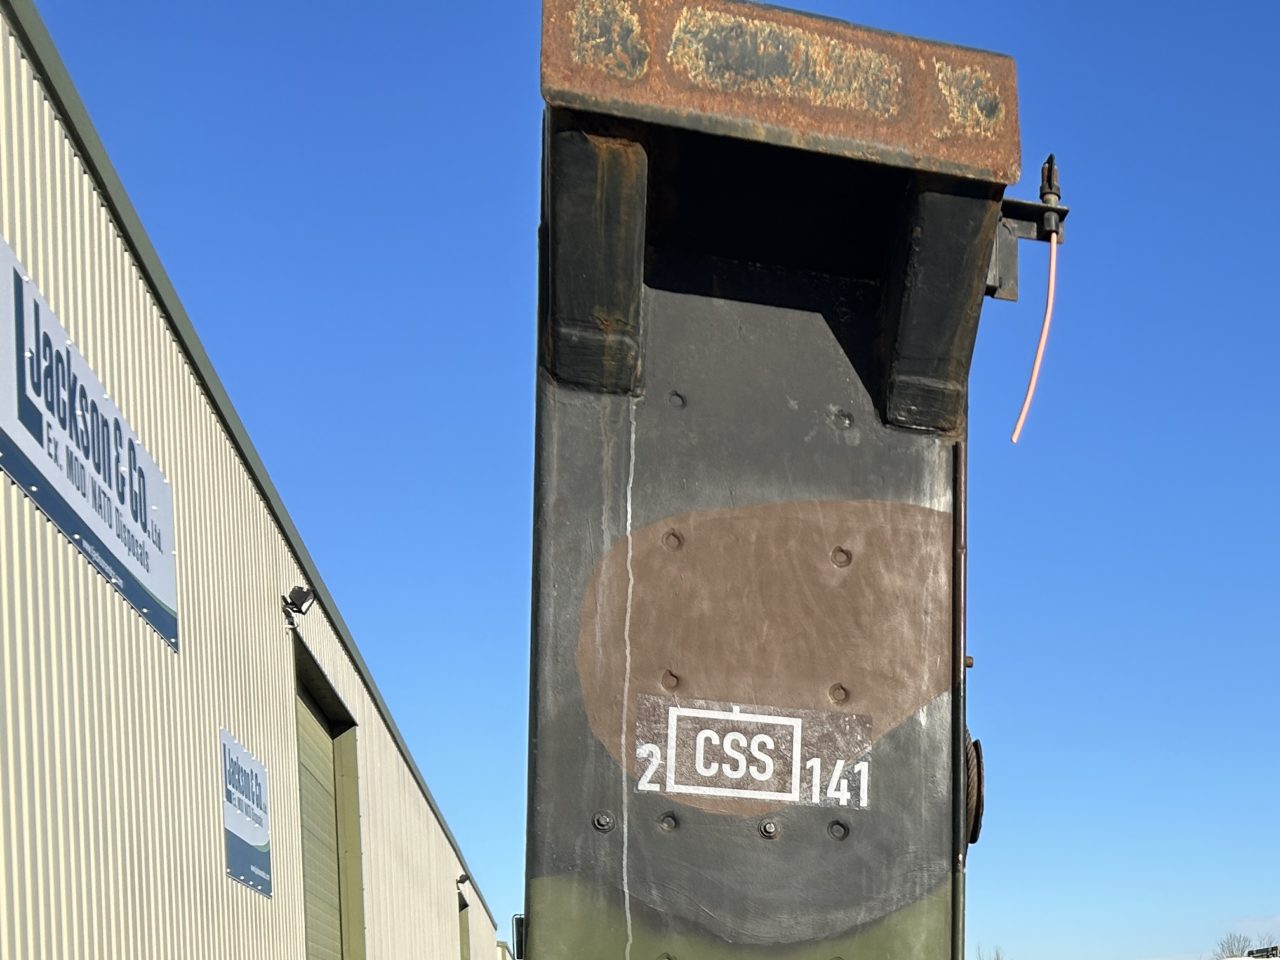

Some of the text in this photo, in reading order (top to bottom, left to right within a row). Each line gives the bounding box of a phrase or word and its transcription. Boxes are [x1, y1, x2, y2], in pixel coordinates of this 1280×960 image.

[29, 299, 112, 490] Jackson
[113, 417, 126, 505] &
[115, 505, 150, 574] Disposals
[635, 729, 869, 807] 2 CSS 141
